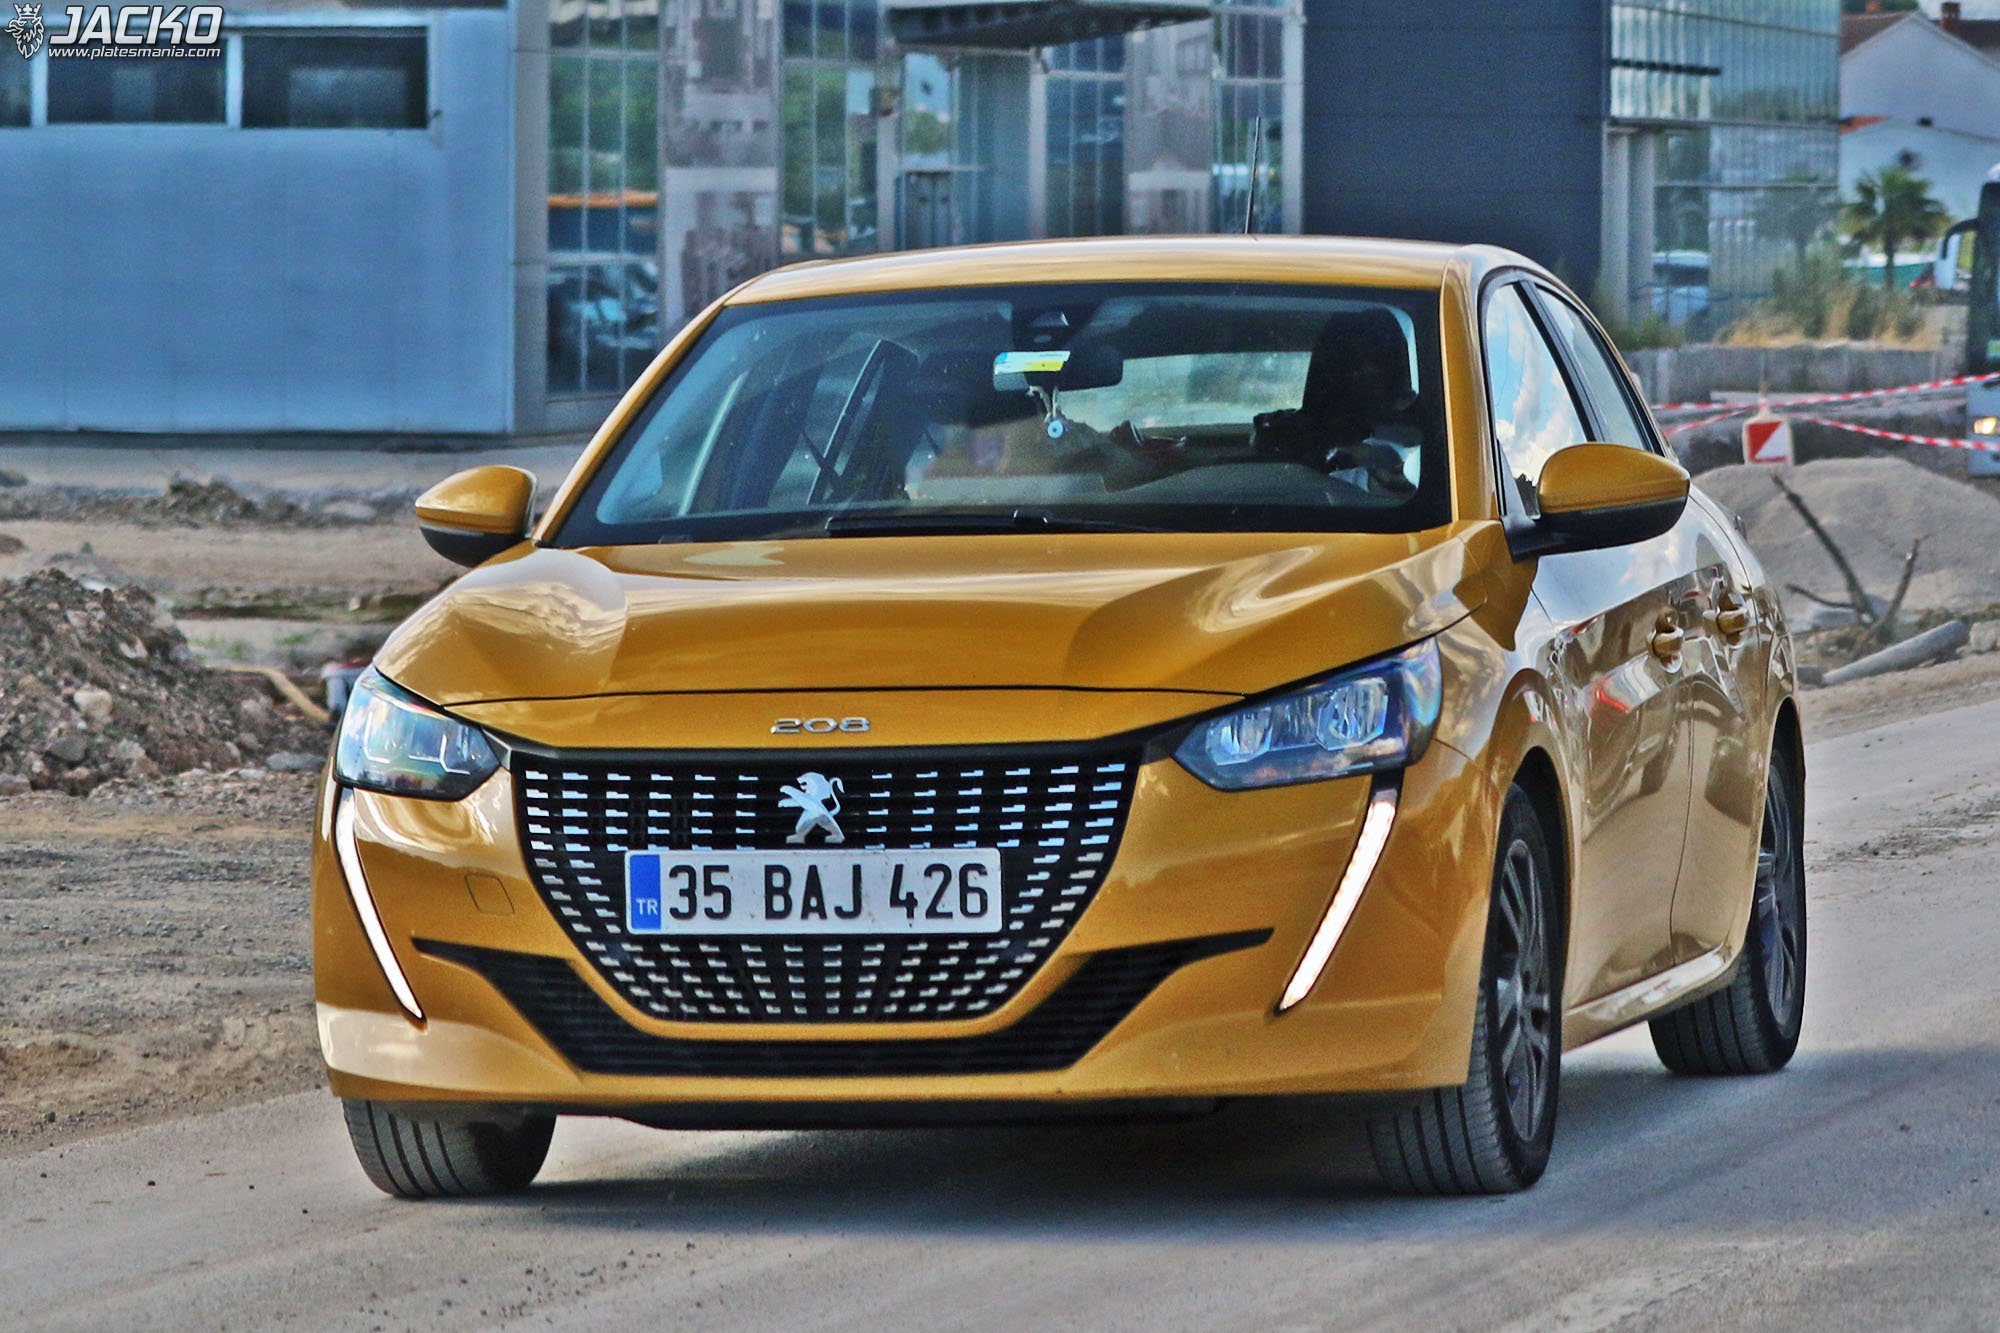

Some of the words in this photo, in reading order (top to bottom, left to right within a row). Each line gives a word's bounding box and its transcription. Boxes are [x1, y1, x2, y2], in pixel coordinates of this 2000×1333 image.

[770, 717, 872, 734] 208
[669, 864, 732, 921] 35
[764, 864, 863, 920] BAJ
[889, 863, 989, 919] 426
[636, 898, 658, 916] TR
